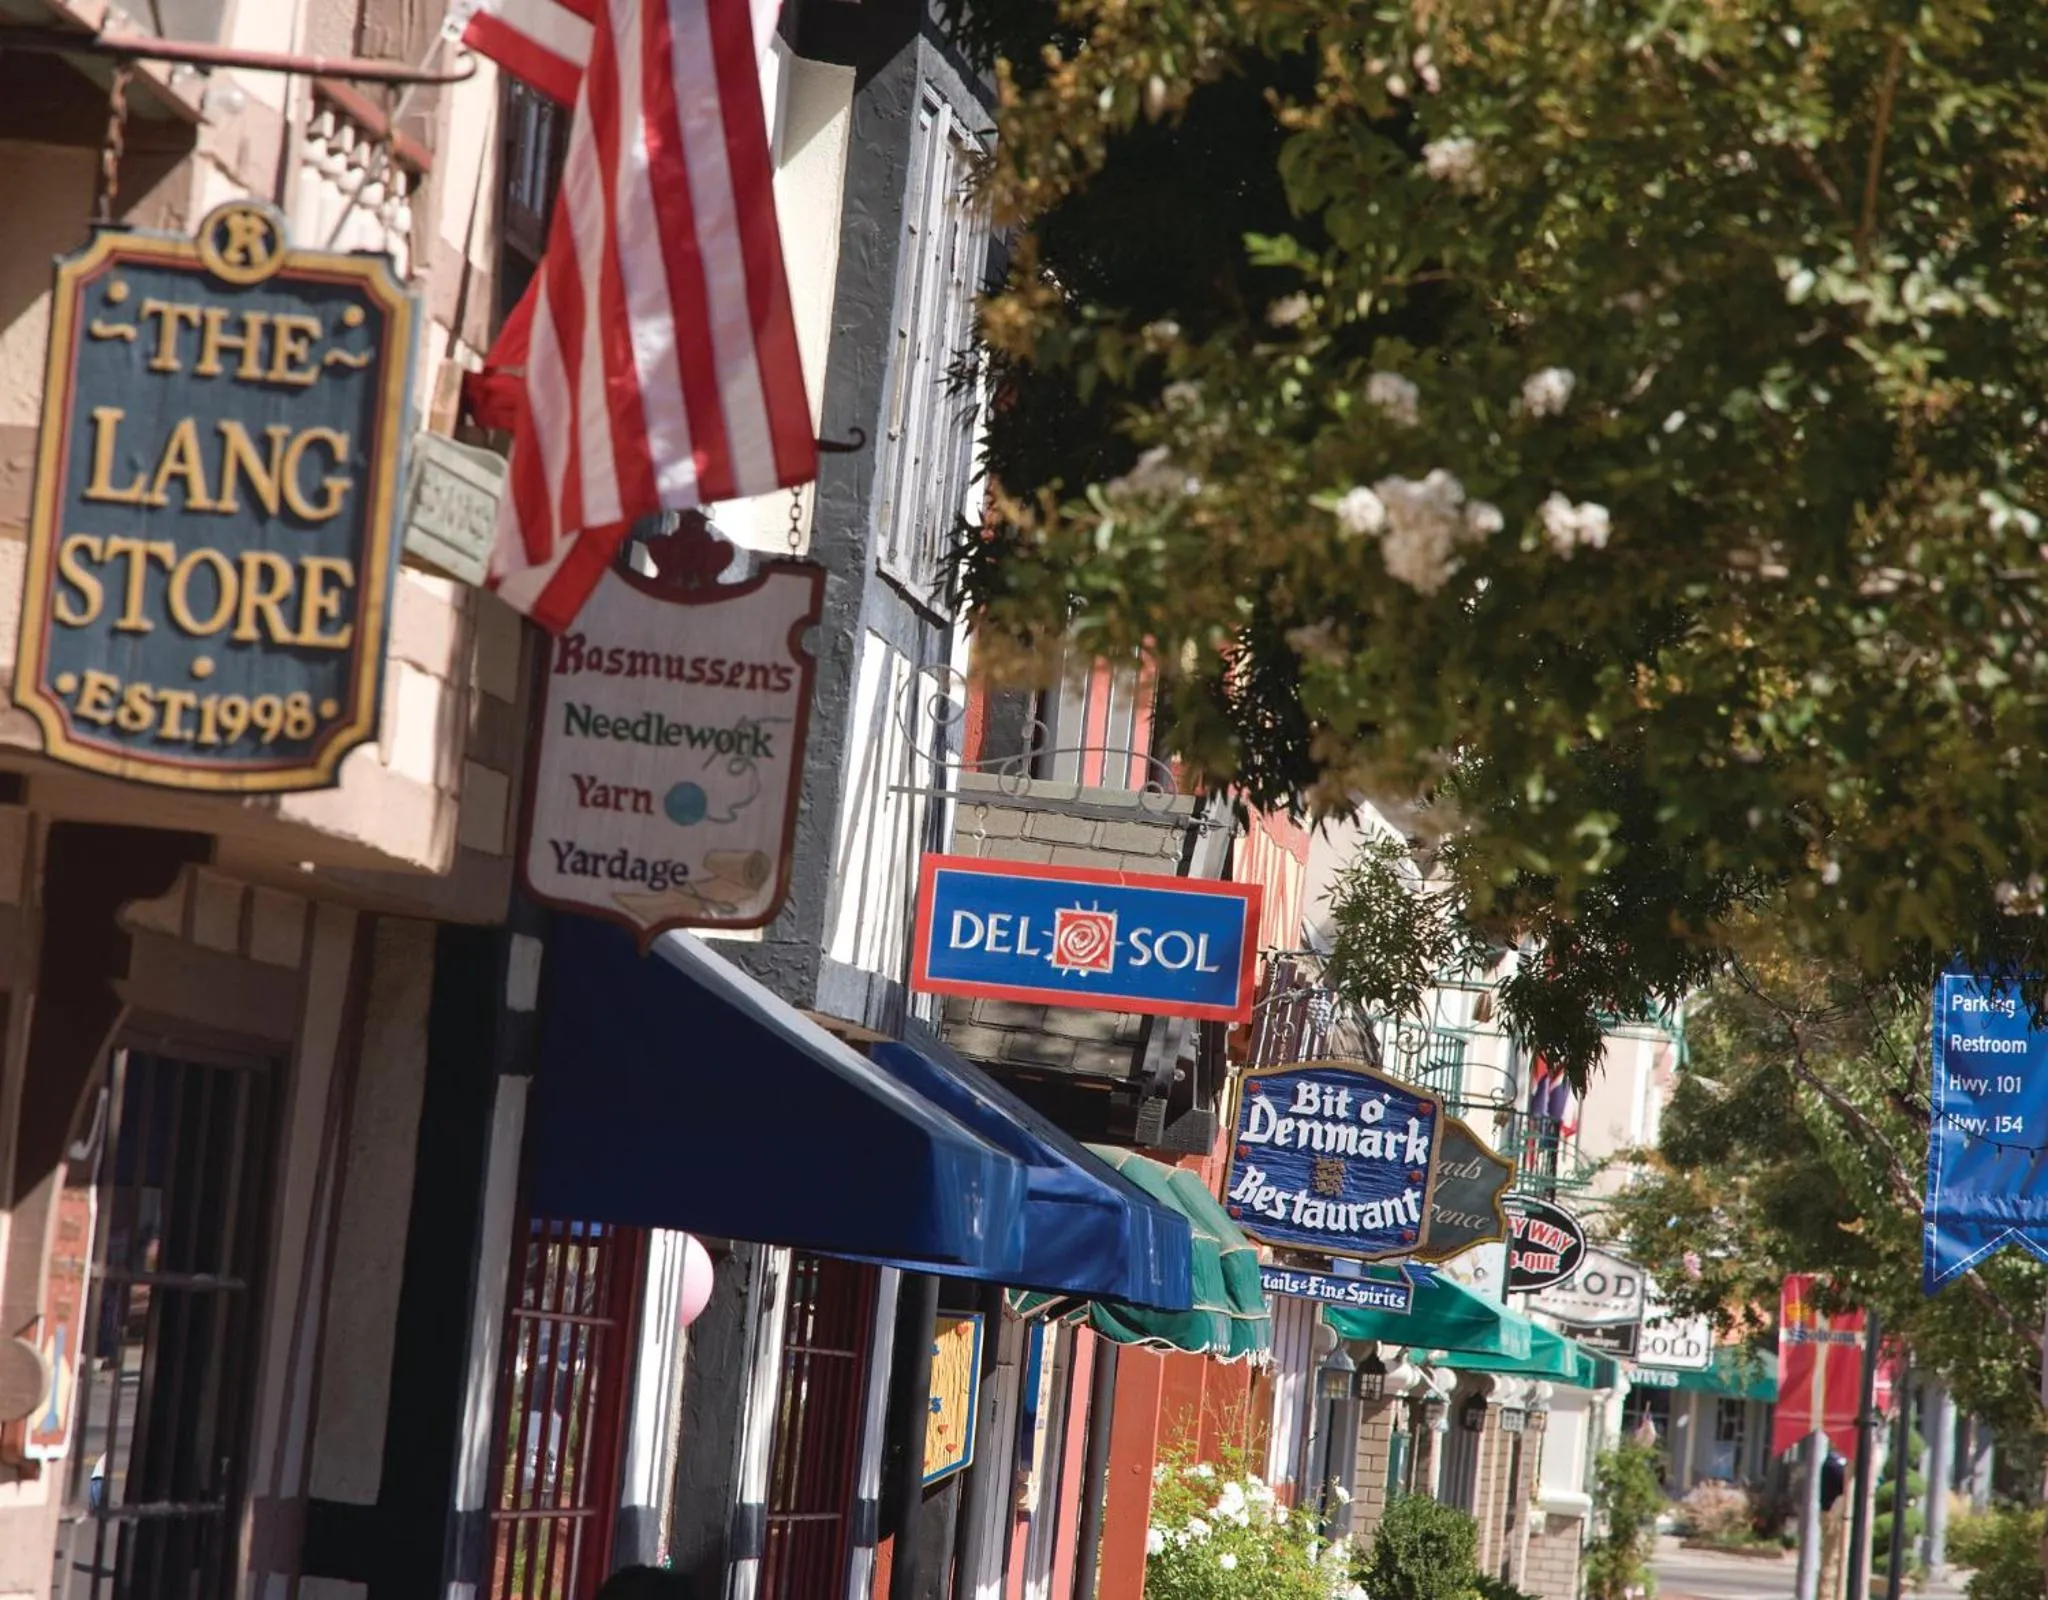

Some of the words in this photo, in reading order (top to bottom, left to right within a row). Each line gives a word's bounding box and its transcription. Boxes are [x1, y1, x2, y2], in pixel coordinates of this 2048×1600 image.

[141, 299, 322, 385] THE
[85, 407, 352, 521] LANG
[54, 533, 357, 650] STORE
[554, 632, 794, 693] Rasmussen's
[564, 702, 775, 759] Needlework
[570, 772, 655, 816] Yarn
[548, 839, 690, 893] Yardage
[949, 909, 1041, 957] DEL
[1128, 927, 1221, 974] SOL
[1950, 1034, 2028, 1055] Restroom
[1288, 1082, 1352, 1119] Bit
[1948, 1074, 1992, 1097] Hwy.
[1996, 1075, 2022, 1094] 101
[1239, 1094, 1429, 1166] Denmark
[1947, 1113, 1991, 1137] Hwy.
[1994, 1115, 2024, 1134] 154
[1229, 1165, 1422, 1232] Restaurant
[1527, 1219, 1577, 1255] WAY
[1260, 1272, 1299, 1293] tails
[1306, 1276, 1346, 1300] Fine
[1345, 1282, 1406, 1309] Spirits
